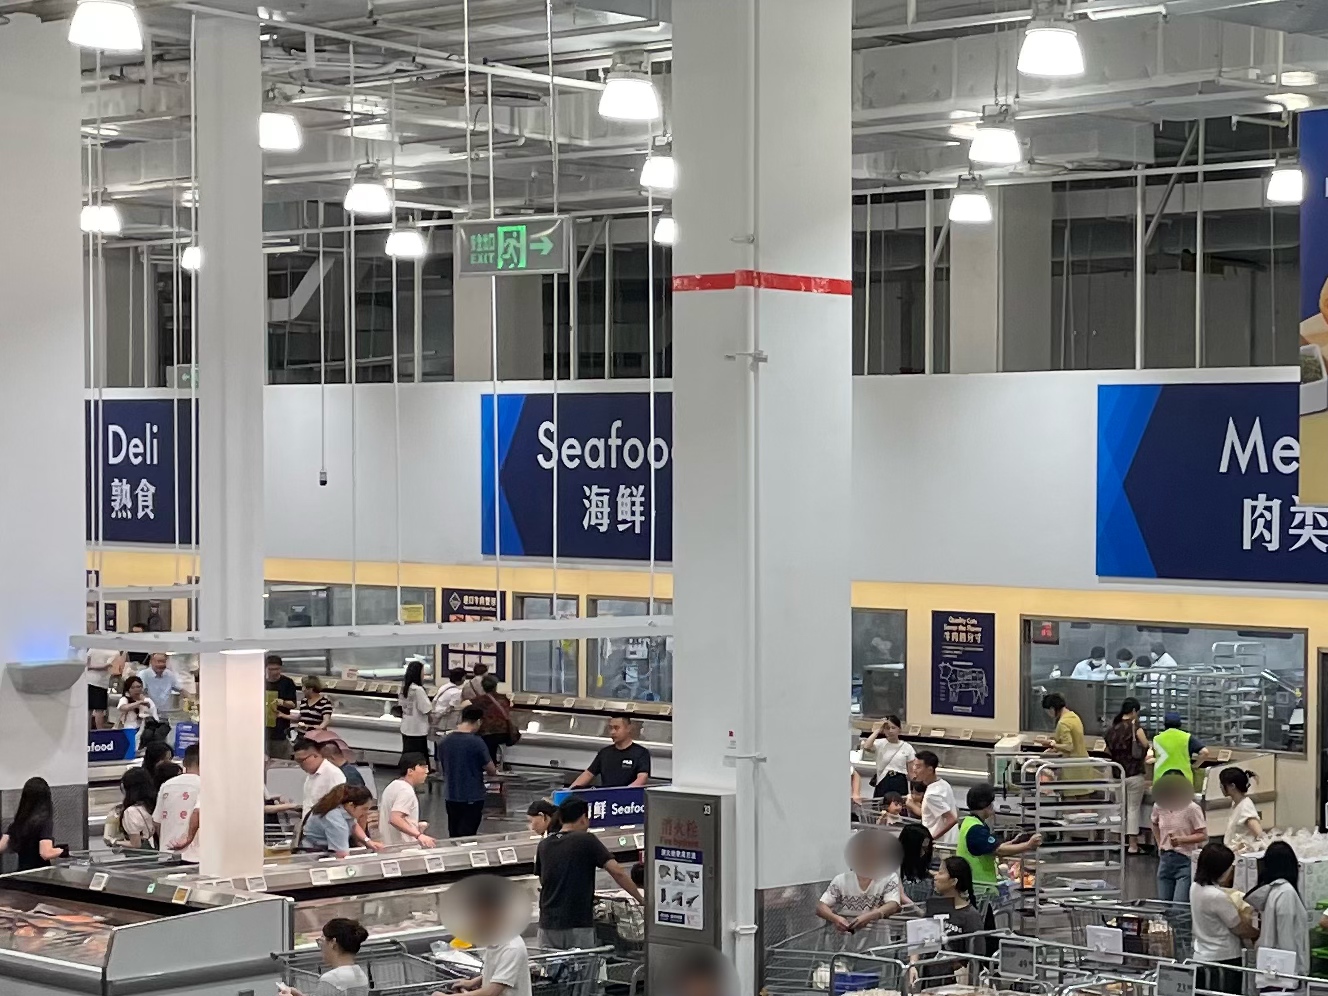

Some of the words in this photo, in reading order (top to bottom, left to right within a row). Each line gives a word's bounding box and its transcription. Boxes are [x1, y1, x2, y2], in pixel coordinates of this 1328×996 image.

[470, 251, 495, 265] EXIT
[107, 422, 158, 465] Deli
[110, 477, 157, 520] 熟食
[582, 484, 646, 534] 海鲜
[948, 615, 966, 625] Quality
